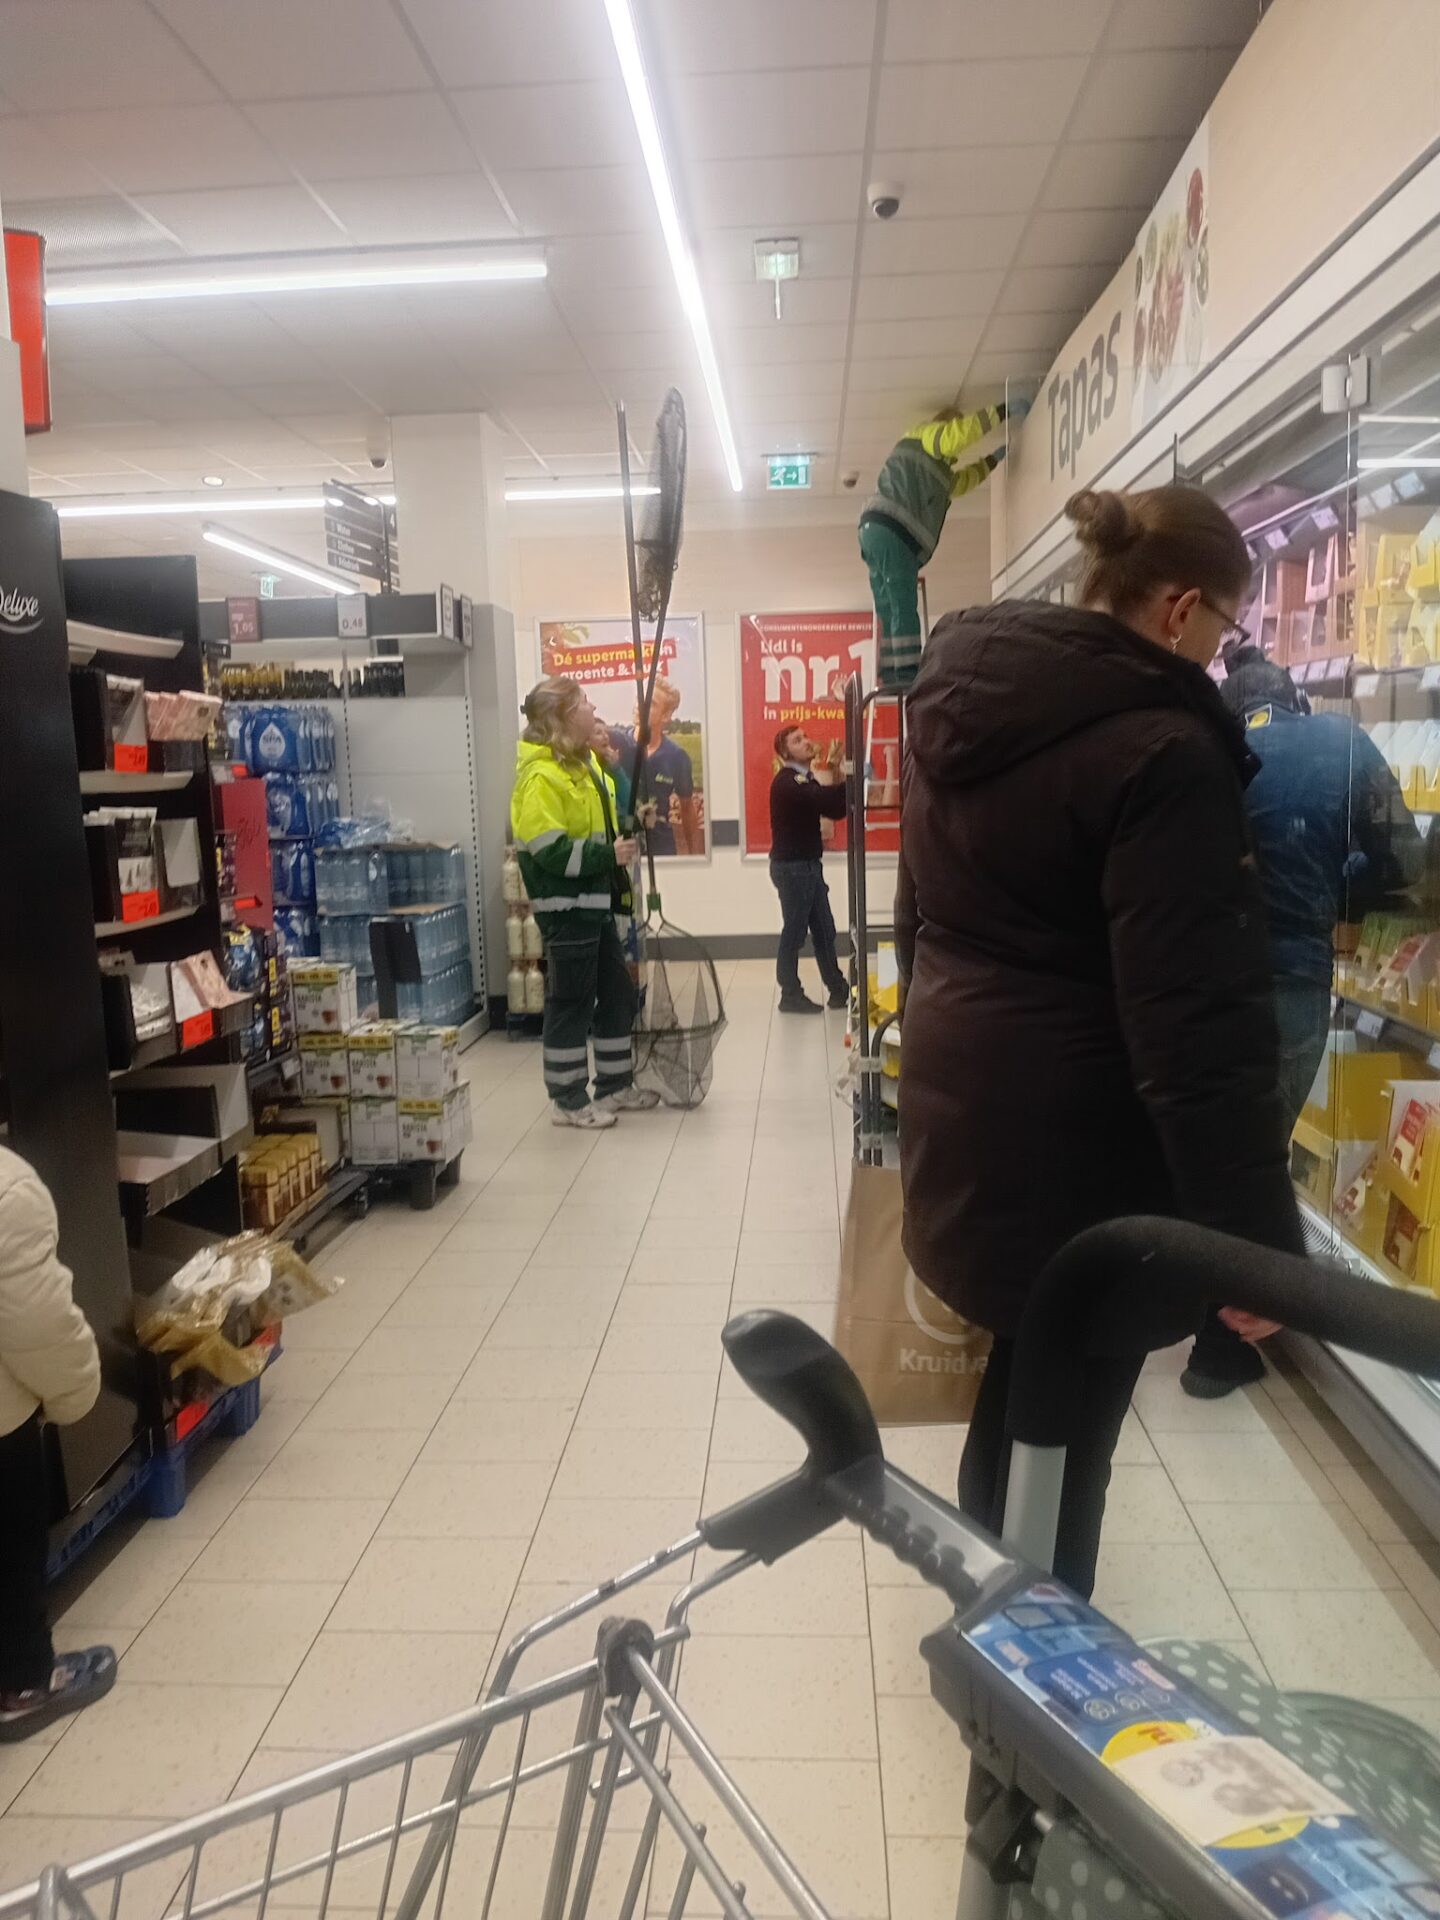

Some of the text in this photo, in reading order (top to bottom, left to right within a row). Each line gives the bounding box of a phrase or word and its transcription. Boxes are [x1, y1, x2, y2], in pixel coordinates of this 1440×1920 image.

[1048, 312, 1121, 482] Tapas
[553, 652, 572, 666] Dé
[576, 642, 654, 666] supermakt
[760, 638, 787, 653] Lidl
[617, 662, 631, 676] &
[763, 705, 777, 720] in
[900, 1347, 989, 1375] Kruidva
